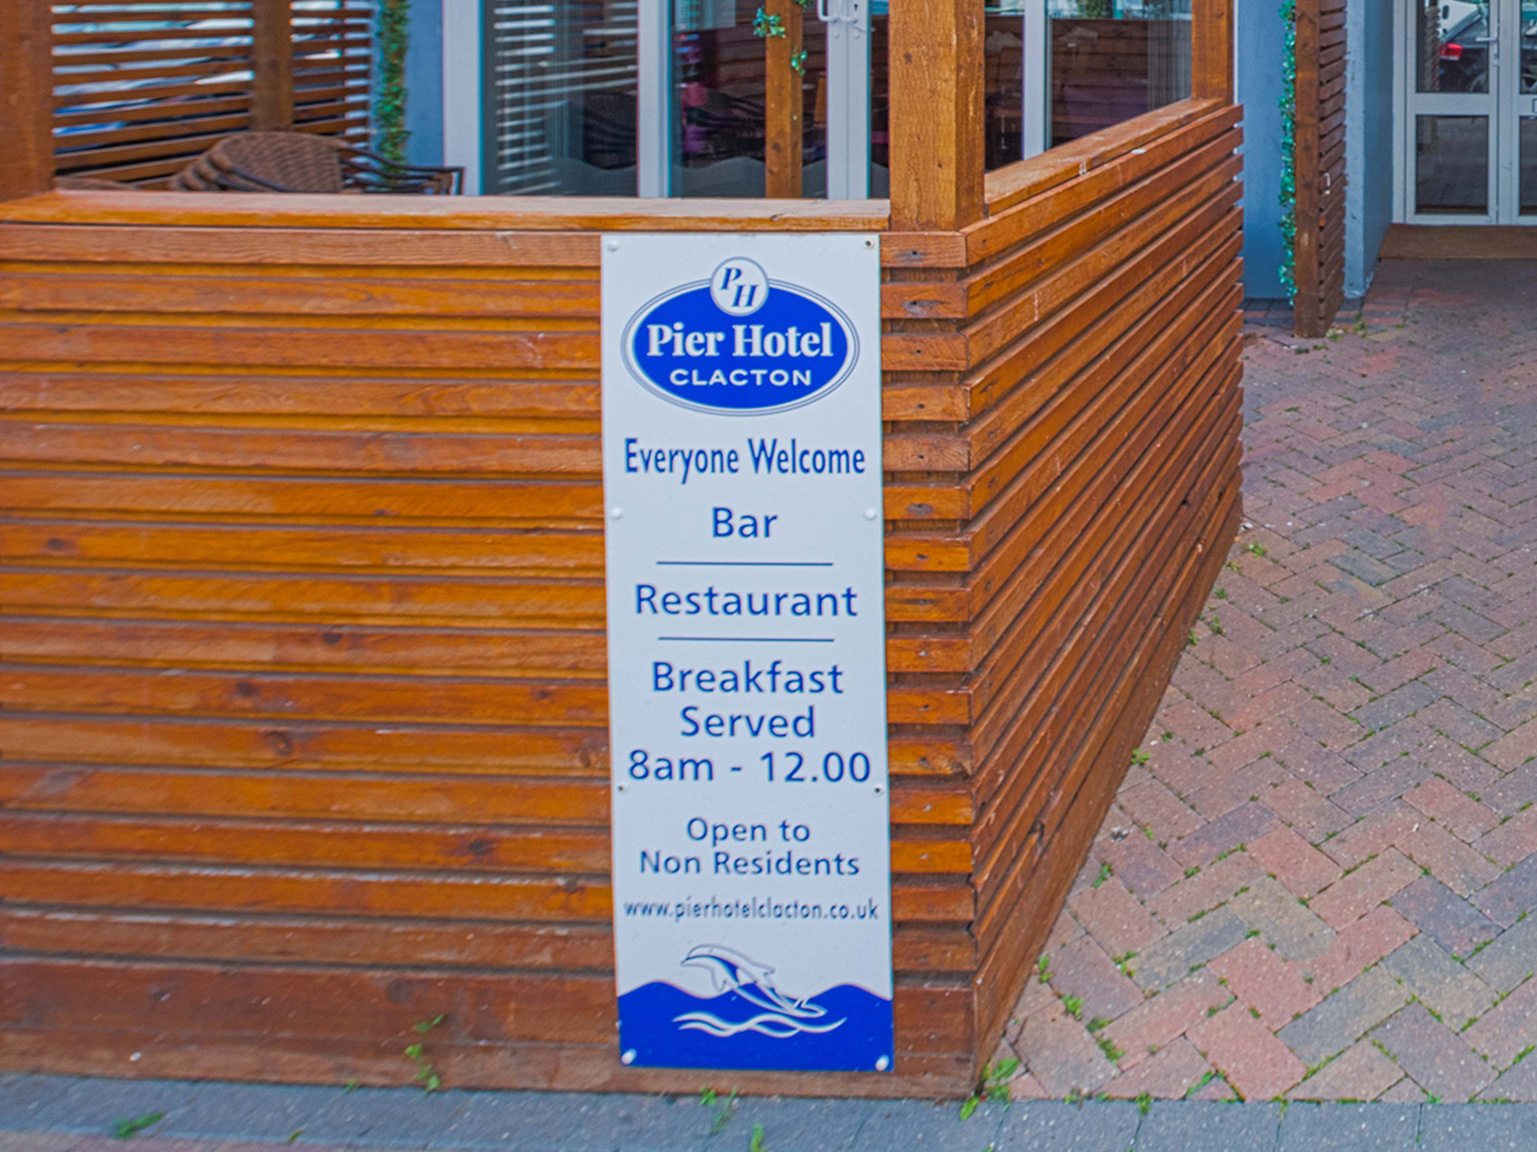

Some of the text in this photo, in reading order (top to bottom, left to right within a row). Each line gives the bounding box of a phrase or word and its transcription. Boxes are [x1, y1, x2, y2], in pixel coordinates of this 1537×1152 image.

[646, 321, 833, 358] Pier Hotel
[669, 369, 812, 386] CLACTON
[624, 437, 866, 485] Everyone Welcome
[712, 507, 778, 538] Bar
[635, 584, 858, 617] Restaurant
[652, 660, 844, 694] Breakfast
[680, 705, 815, 738] Served
[628, 749, 714, 781] 8am
[760, 751, 871, 783] 12.00
[686, 817, 811, 847] Open to
[640, 850, 860, 876] Non Residents
[624, 896, 879, 922] www.pierhotelclacton.co.uk
